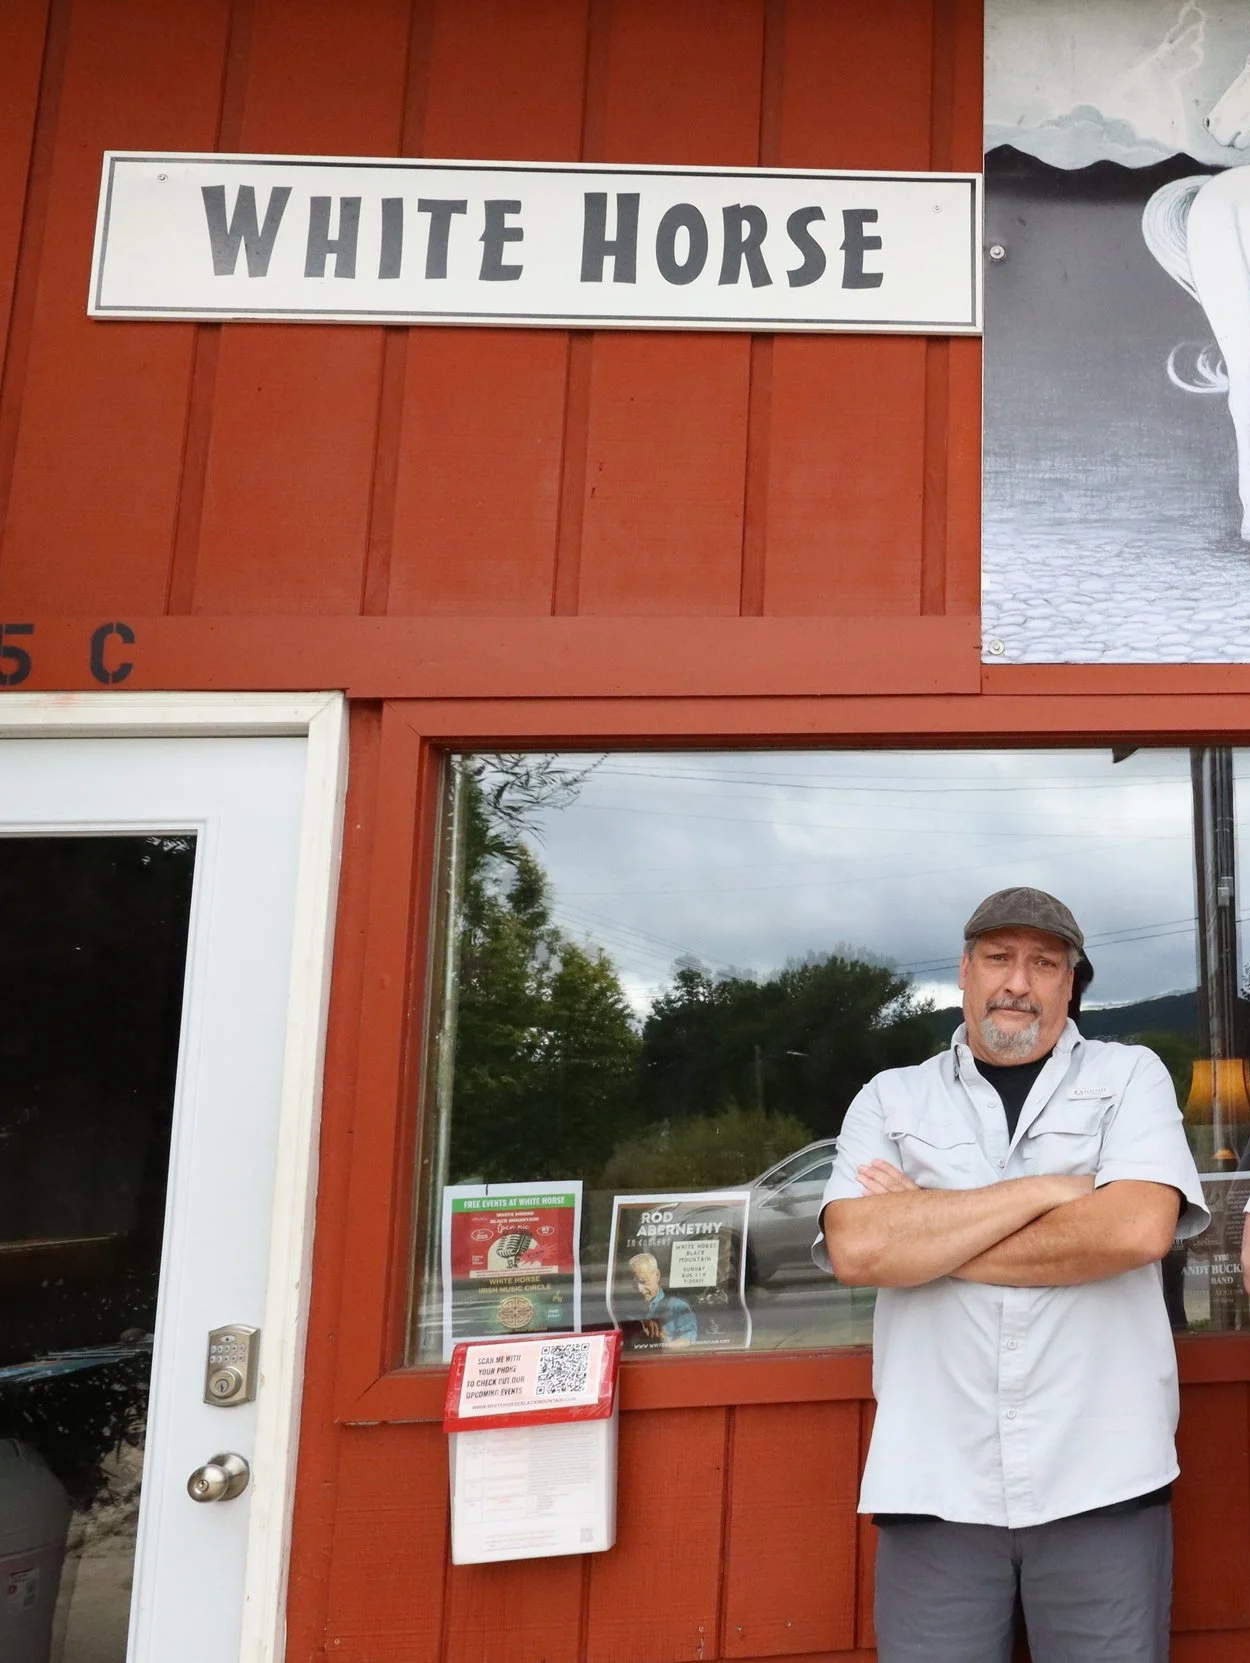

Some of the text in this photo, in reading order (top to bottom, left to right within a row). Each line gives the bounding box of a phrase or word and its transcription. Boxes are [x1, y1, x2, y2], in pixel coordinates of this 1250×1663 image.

[201, 184, 884, 290] WHITE HORSE
[89, 622, 136, 685] C
[464, 1196, 565, 1209] FREE EVENTS AT WHITE HORSE
[641, 1211, 673, 1224] ROD
[636, 1222, 723, 1237] ABERNETHY
[1213, 1254, 1229, 1262] THE
[1181, 1263, 1244, 1275] ANDY BUCK
[489, 1275, 541, 1286] WHITE HORSE
[1210, 1276, 1234, 1285] BAND
[478, 1284, 552, 1295] IRISH MUSIC CIRCLE
[477, 1354, 522, 1366] SCAN ME WITH
[478, 1365, 517, 1377] YOUR PHONE
[466, 1376, 526, 1388] TO CHECK OUT OUR
[465, 1386, 523, 1400] UPCOMING EVENTS
